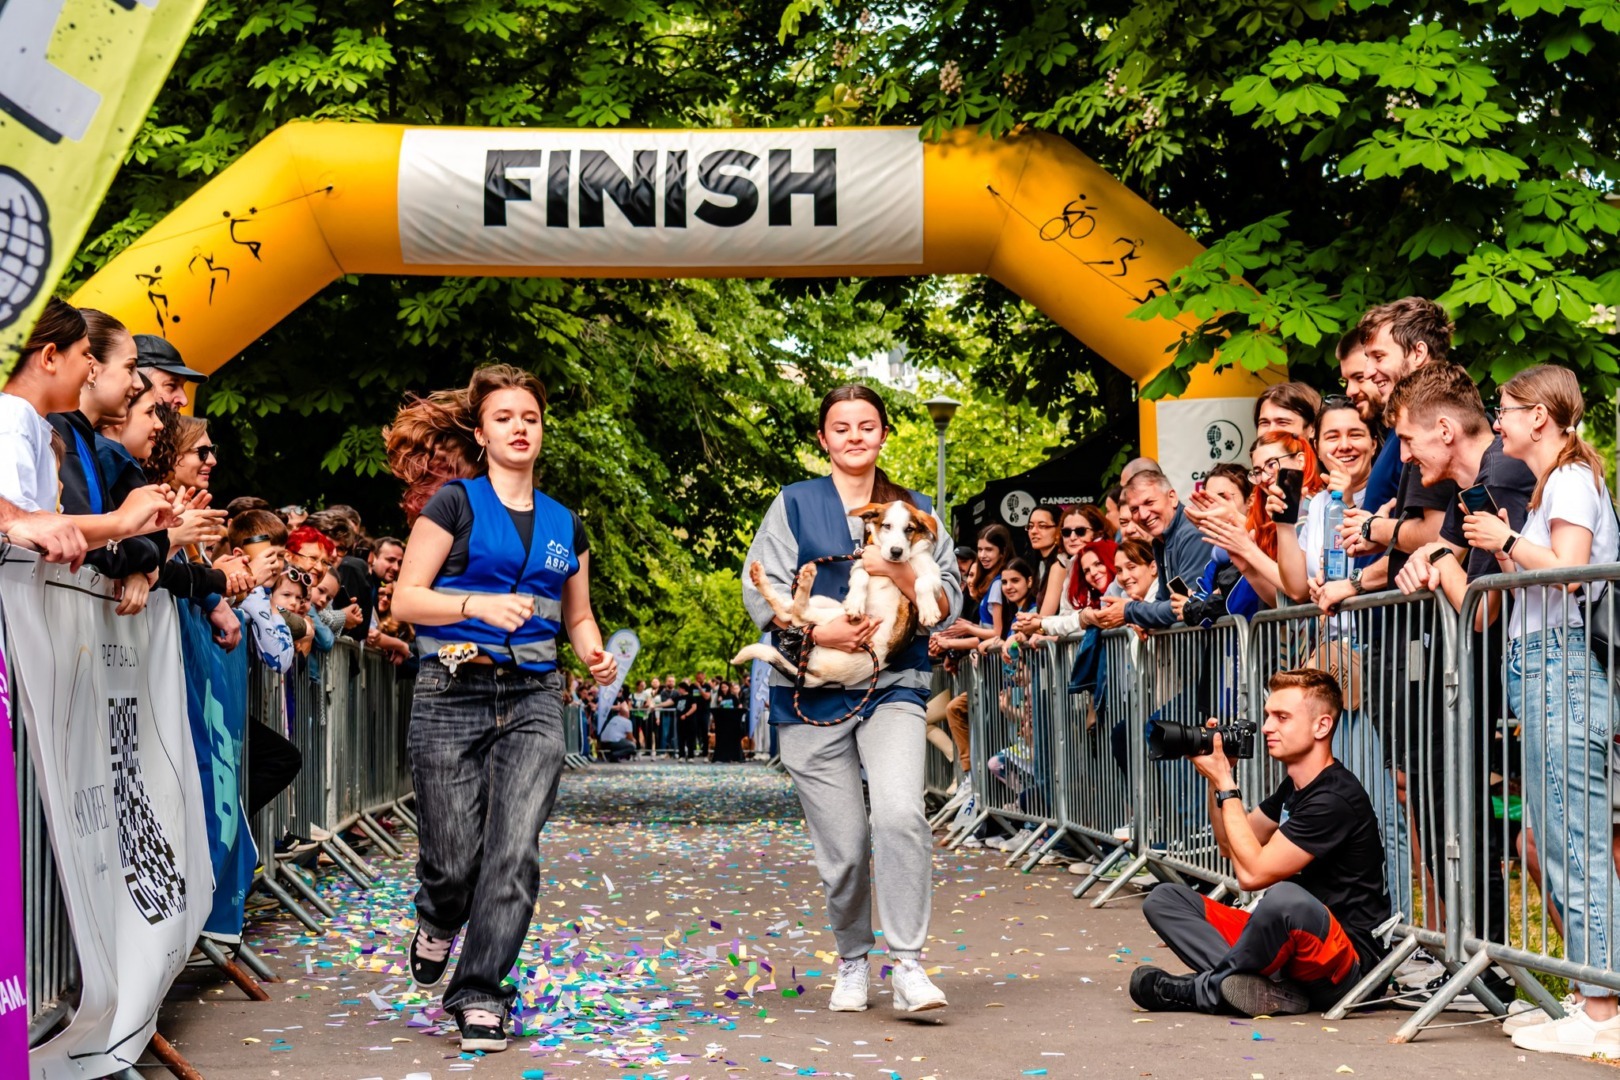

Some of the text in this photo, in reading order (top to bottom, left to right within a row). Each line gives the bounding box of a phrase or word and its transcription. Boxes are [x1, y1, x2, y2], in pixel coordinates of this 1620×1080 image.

[484, 148, 837, 228] FINISH
[1040, 496, 1094, 505] CANICROSS
[545, 555, 569, 572] ASPA
[102, 643, 117, 667] PET
